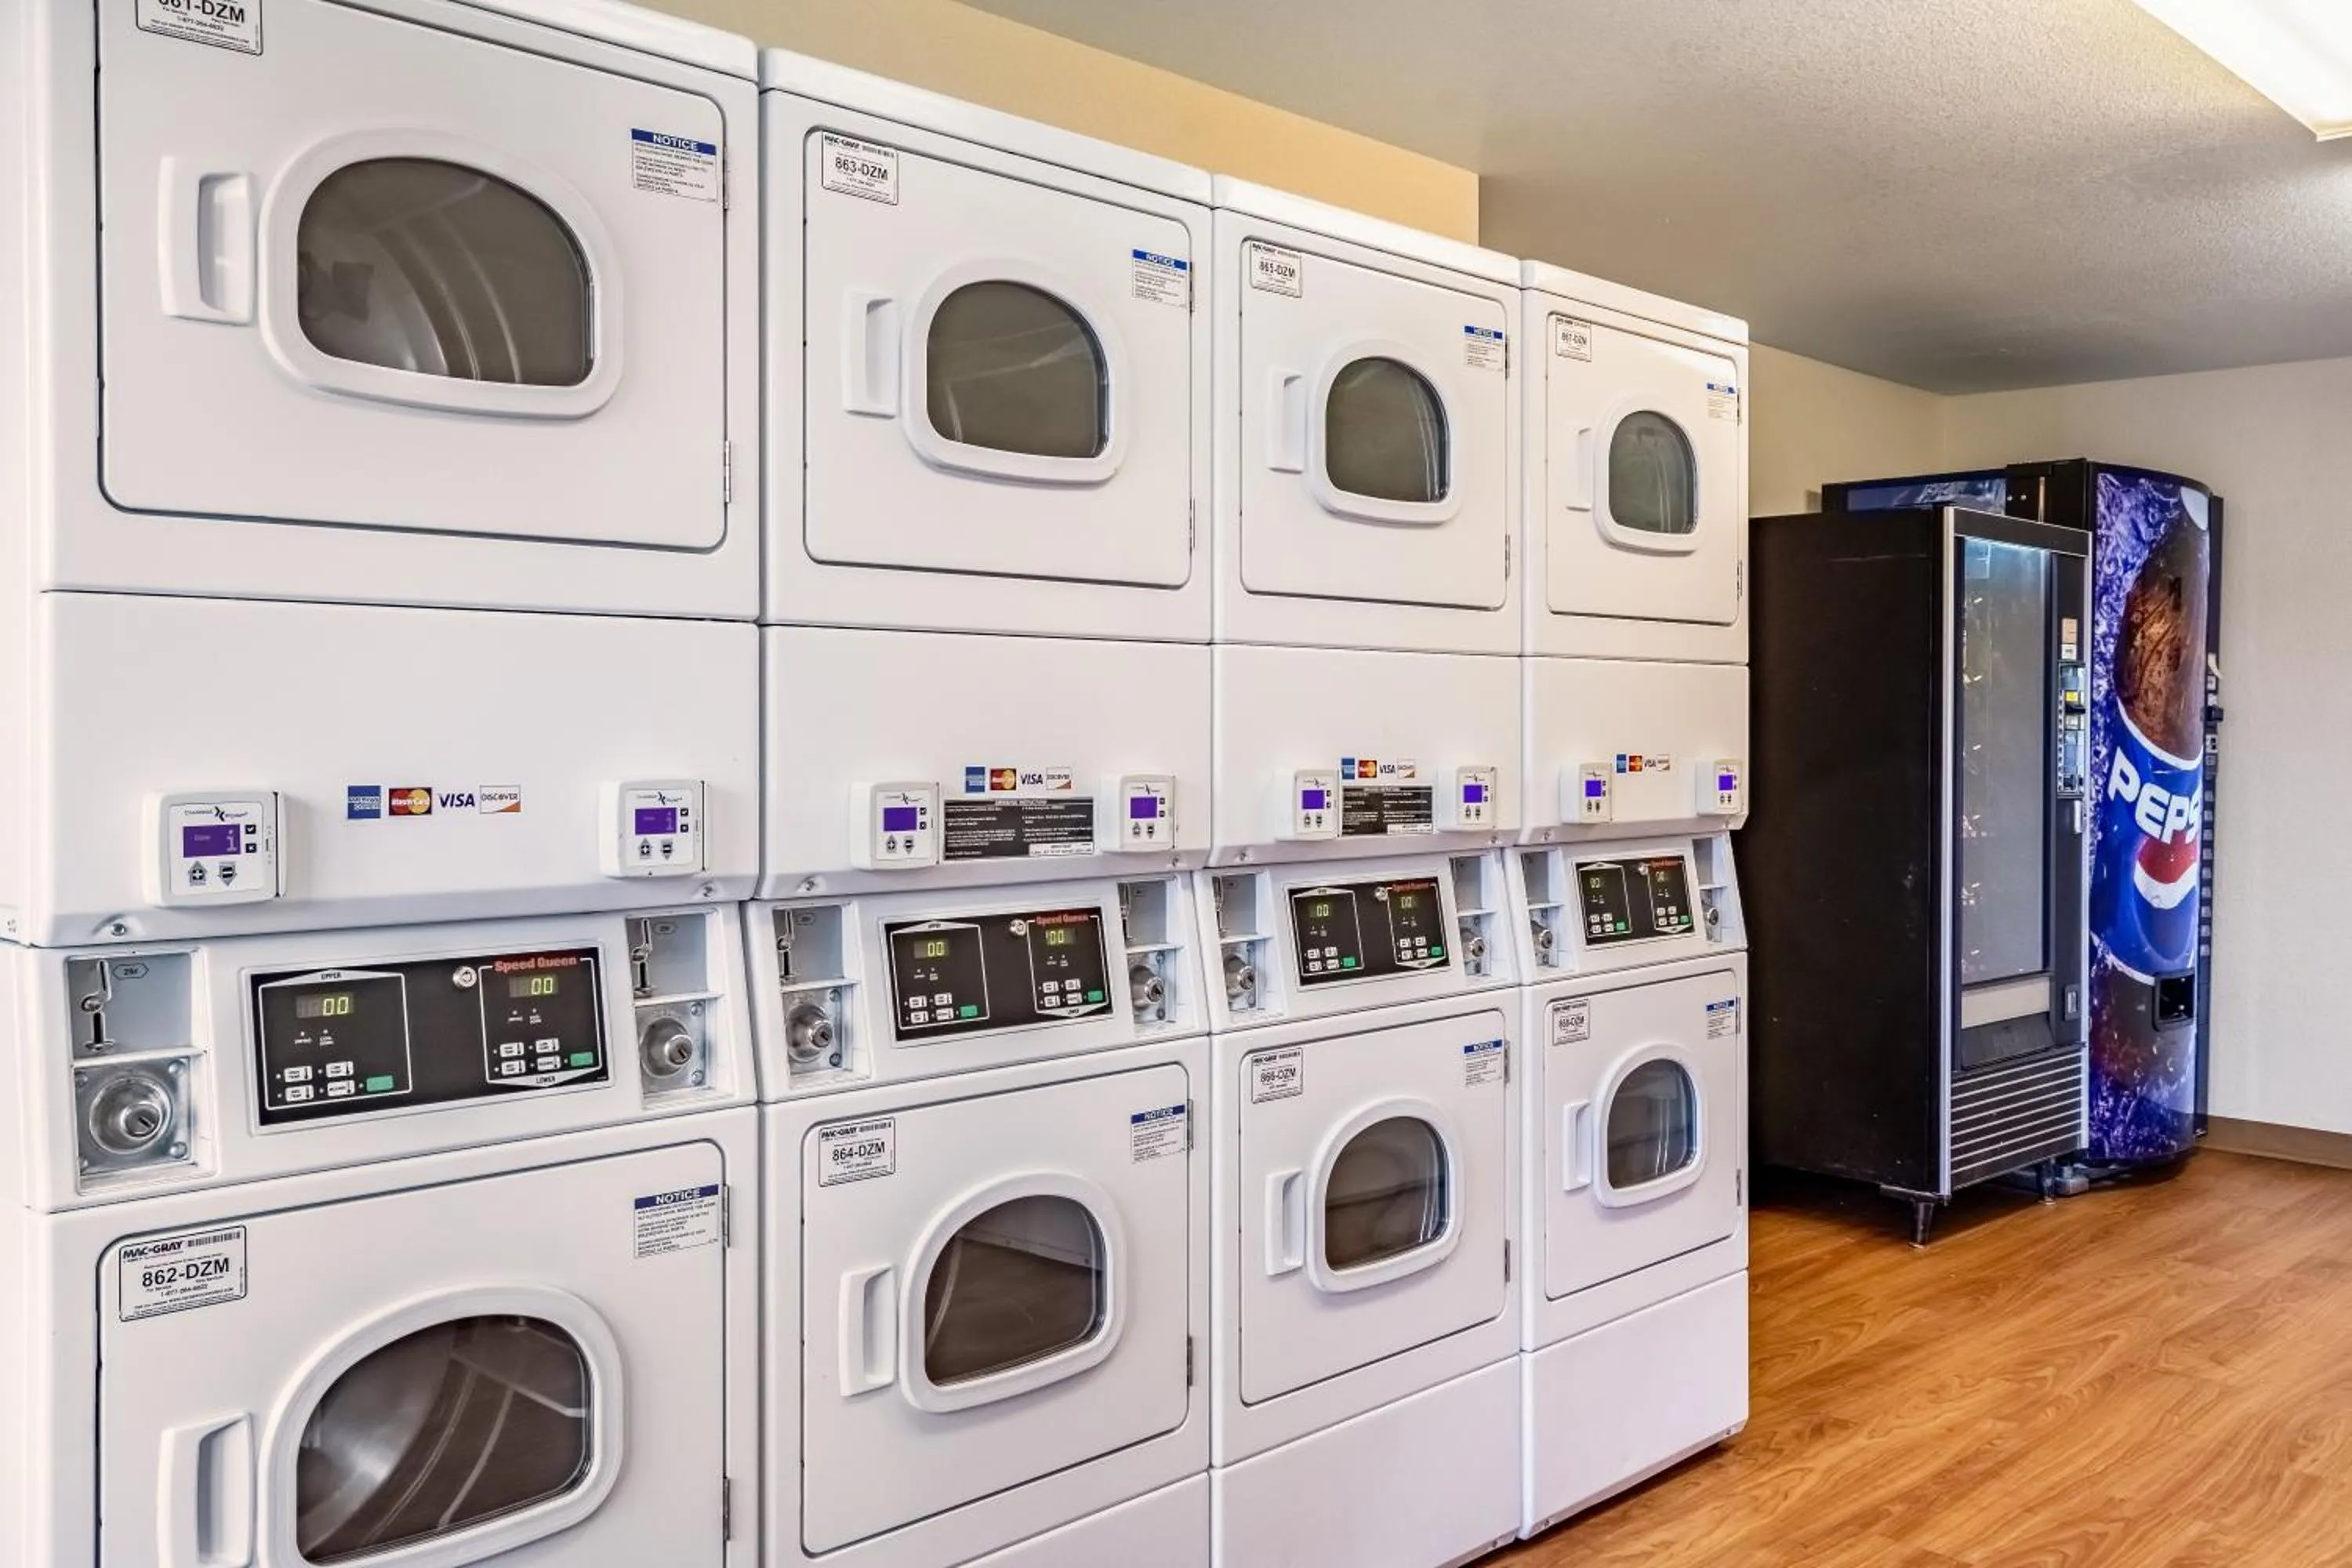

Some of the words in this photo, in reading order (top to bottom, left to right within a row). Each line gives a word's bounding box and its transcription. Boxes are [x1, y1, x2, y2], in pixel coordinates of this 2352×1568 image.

[653, 133, 699, 152] NOTICE
[835, 157, 888, 180] 863-DZM
[1145, 252, 1176, 268] NOTICE
[1379, 764, 1396, 775] VISA
[1020, 773, 1044, 785] VISA
[438, 793, 476, 808] VISA
[480, 793, 518, 801] DISCOVER
[2107, 746, 2201, 844] PEPS
[927, 941, 945, 956] 00
[494, 958, 535, 973] Speed
[536, 956, 578, 968] Queen
[321, 971, 341, 980] UPPER
[531, 977, 554, 996] 00
[322, 996, 350, 1017] 00
[535, 1075, 556, 1084] LOWER
[832, 1141, 885, 1161] 864-DZM
[655, 1188, 701, 1205] NOTICE
[122, 1240, 183, 1260] MAC-GRAY
[142, 1257, 230, 1287] 862-DZM
